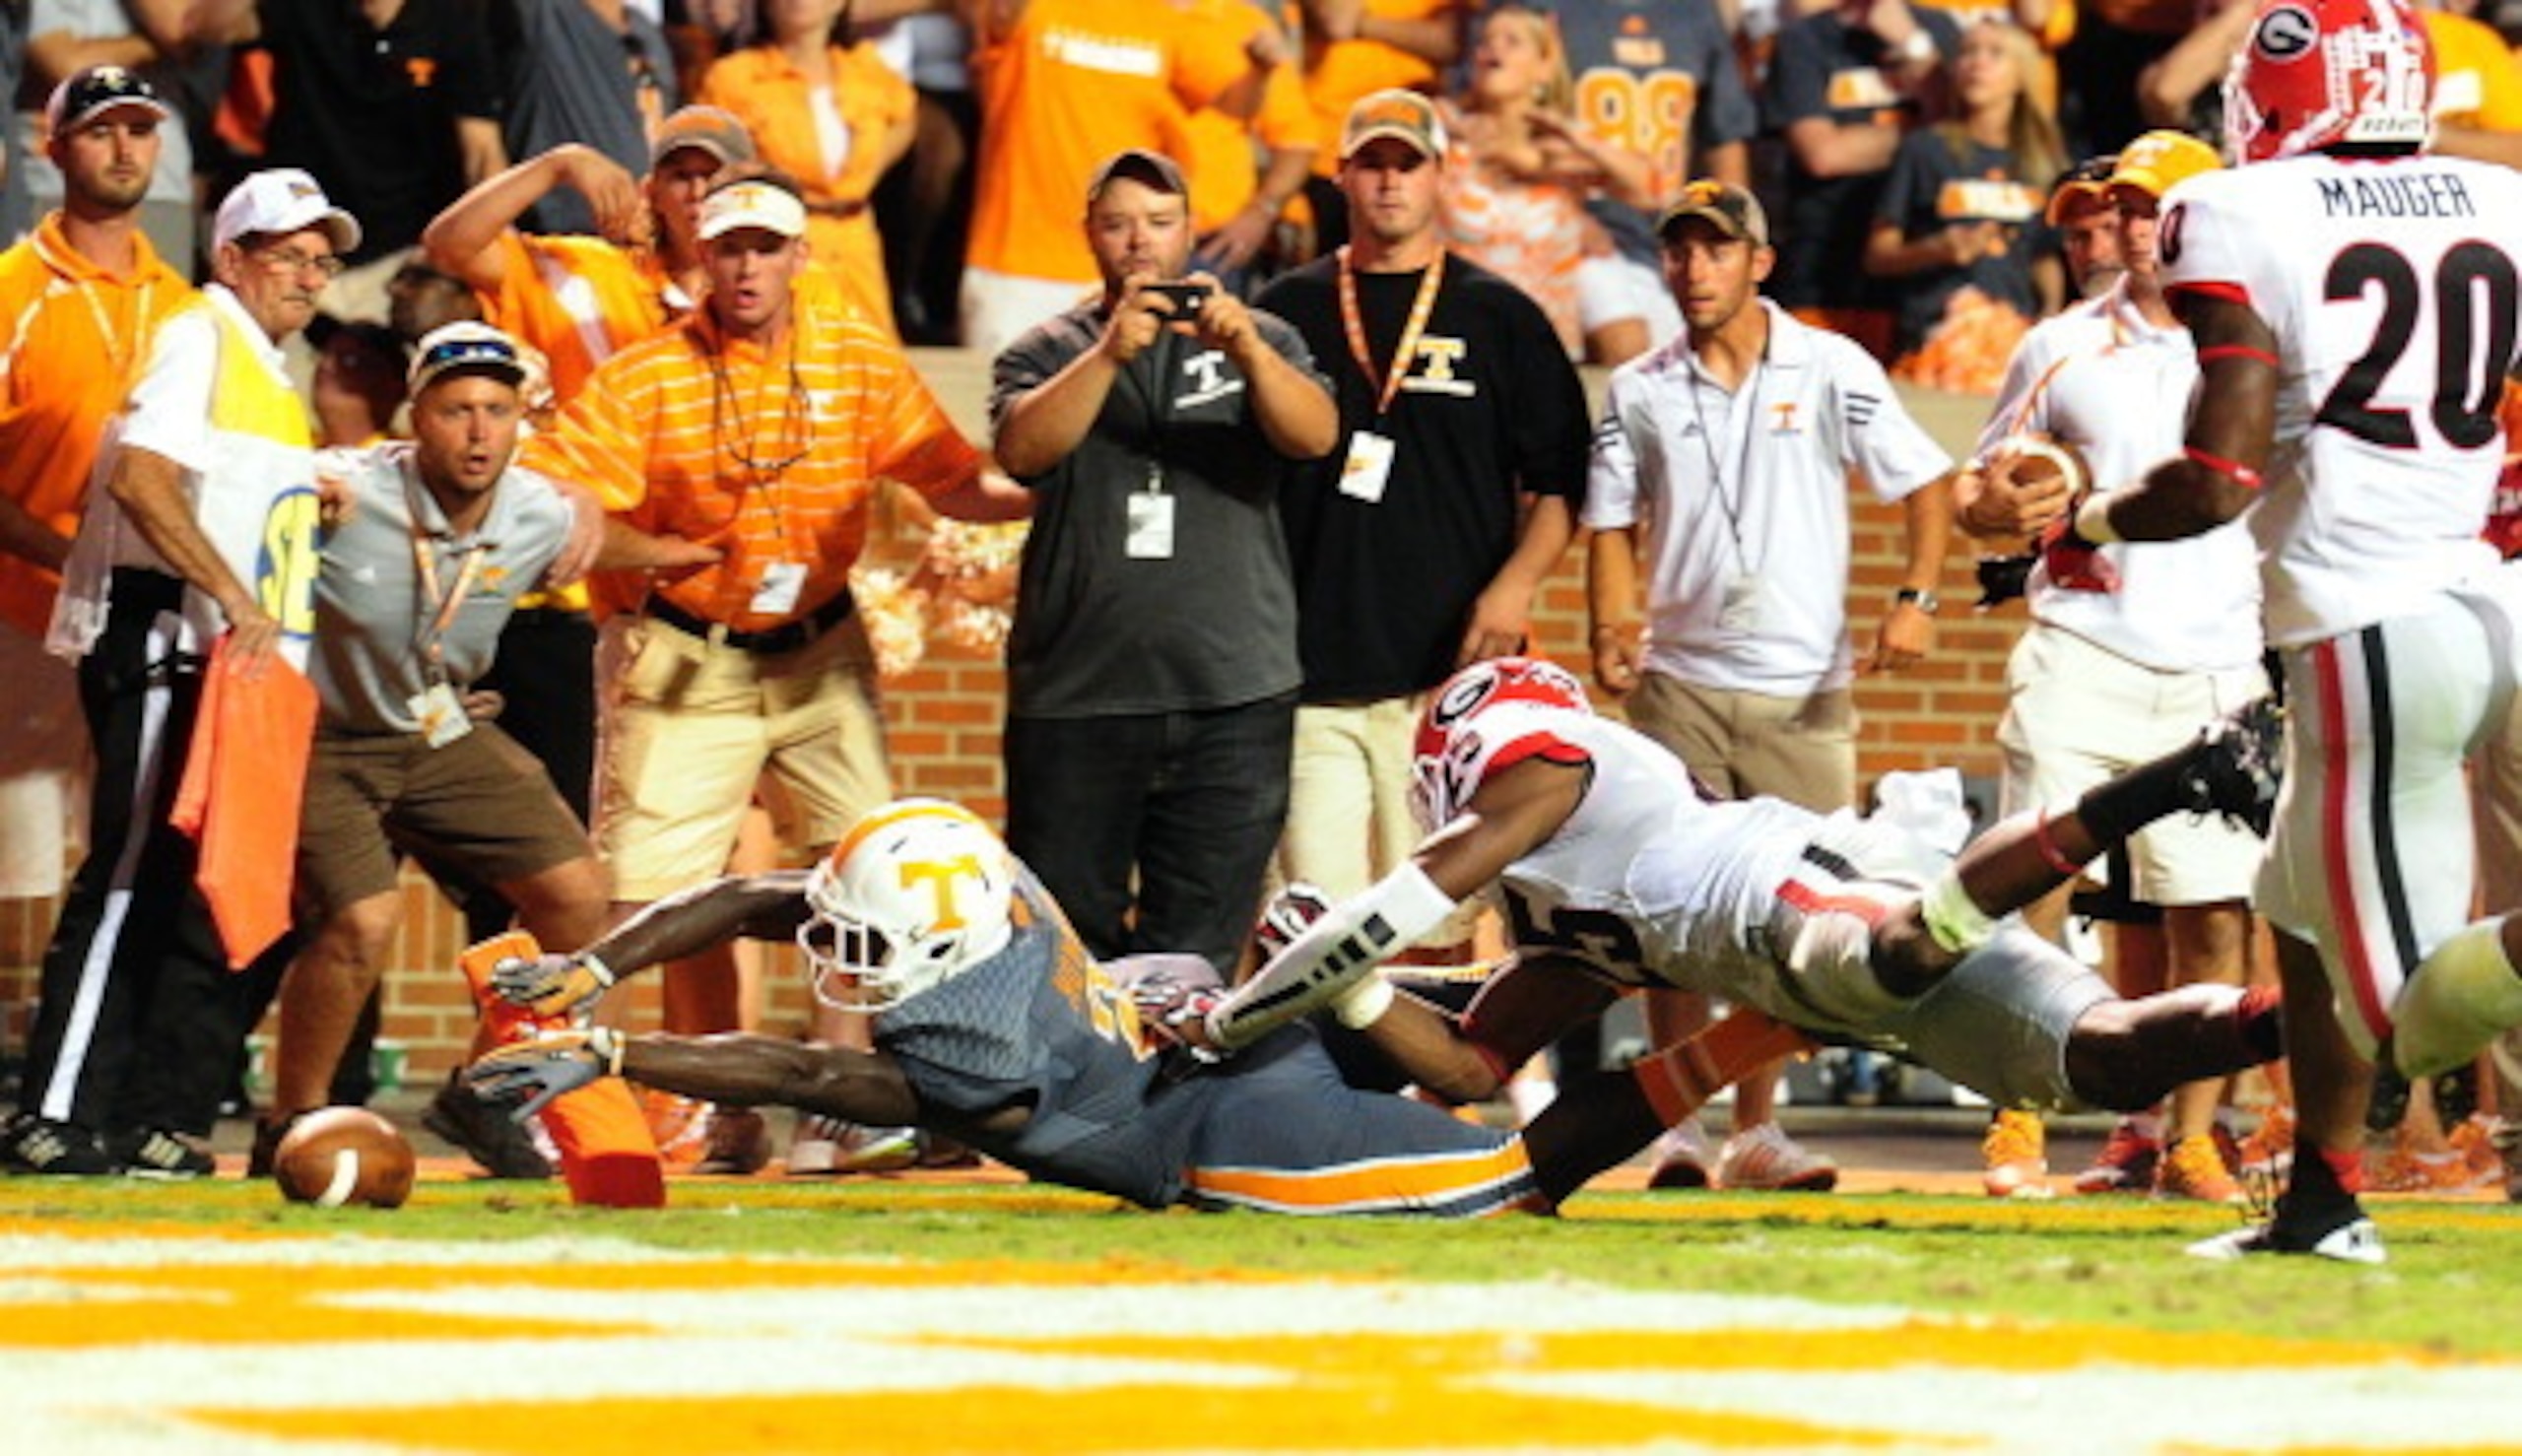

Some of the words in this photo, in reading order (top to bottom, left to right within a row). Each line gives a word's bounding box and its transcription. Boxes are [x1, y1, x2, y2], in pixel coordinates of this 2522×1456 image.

[405, 56, 435, 88] T
[2315, 172, 2477, 218] MAUGER
[1417, 334, 1467, 380] T
[2315, 238, 2518, 451] 20
[1183, 350, 1227, 393] T
[897, 853, 978, 935] T
